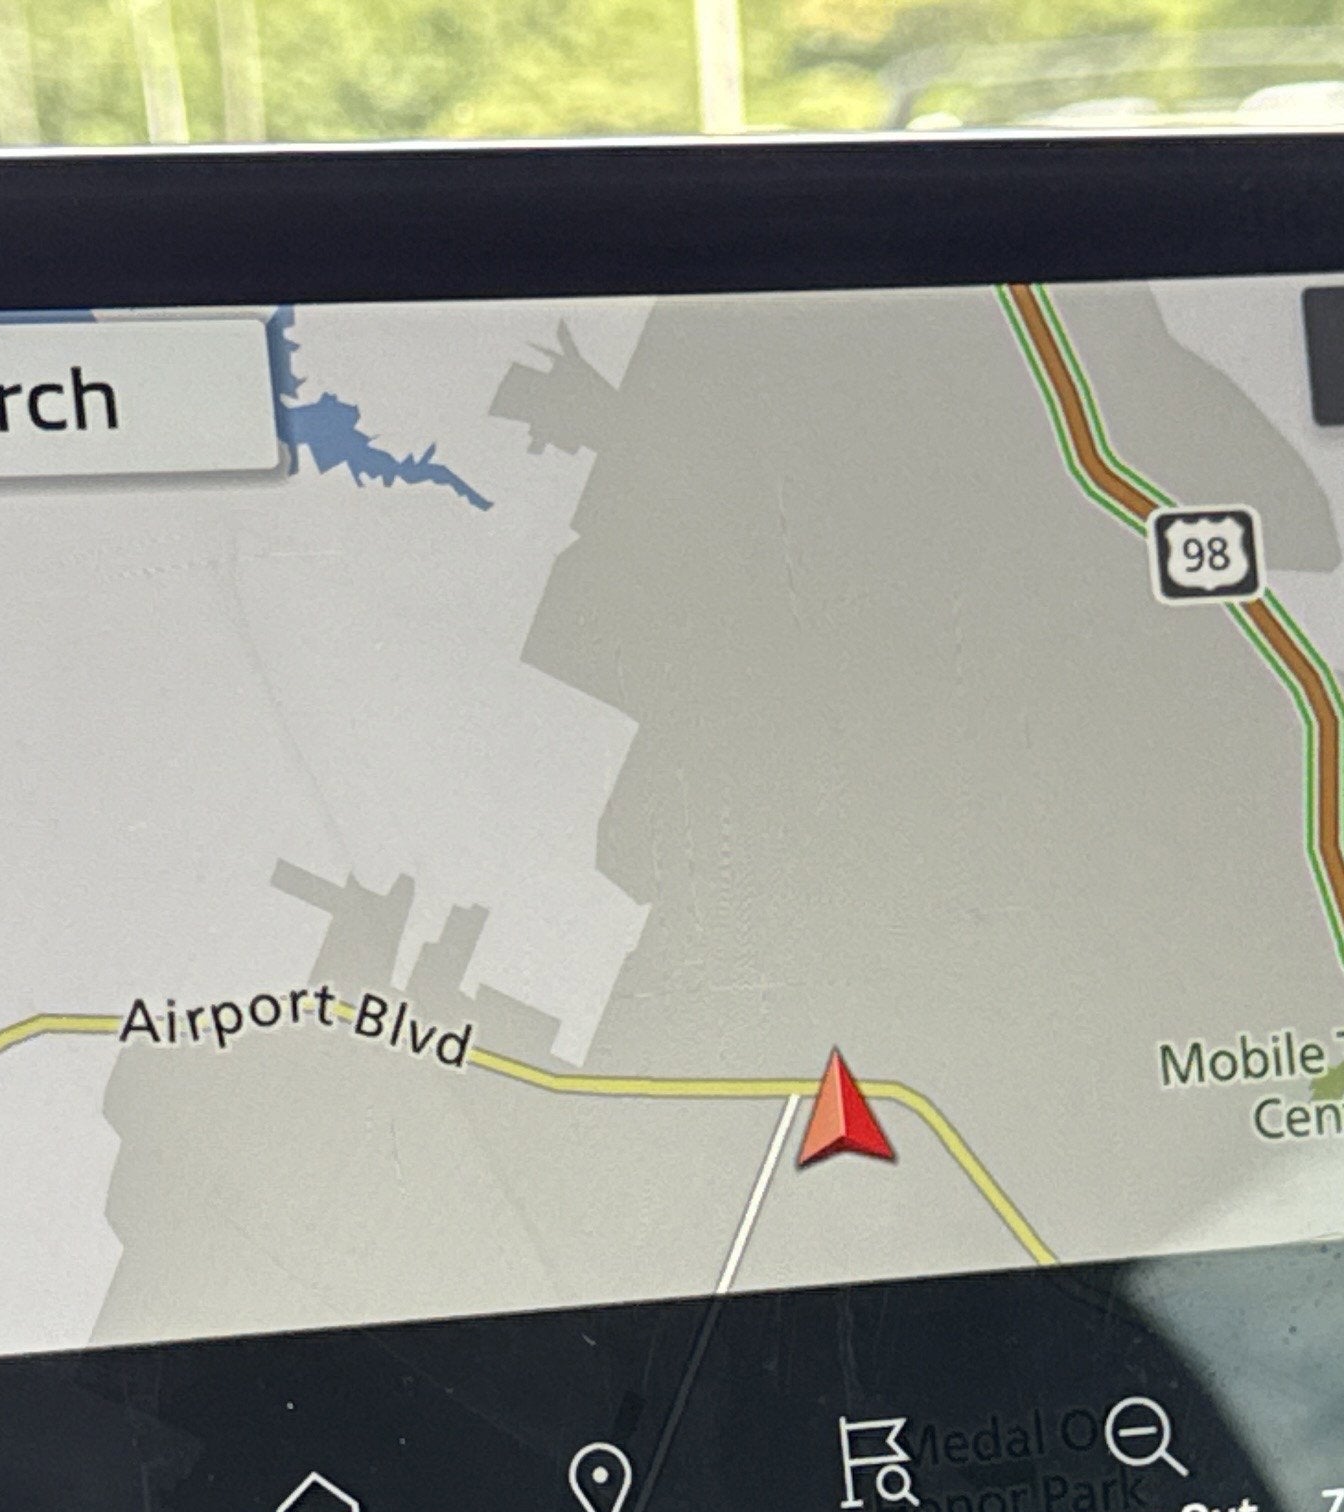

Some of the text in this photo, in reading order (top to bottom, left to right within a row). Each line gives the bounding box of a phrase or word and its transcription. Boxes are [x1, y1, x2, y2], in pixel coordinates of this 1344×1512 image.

[1181, 536, 1232, 574] 98
[119, 984, 473, 1068] Airport Blvd
[1159, 1031, 1325, 1086] Mobile
[1060, 1407, 1106, 1452] O
